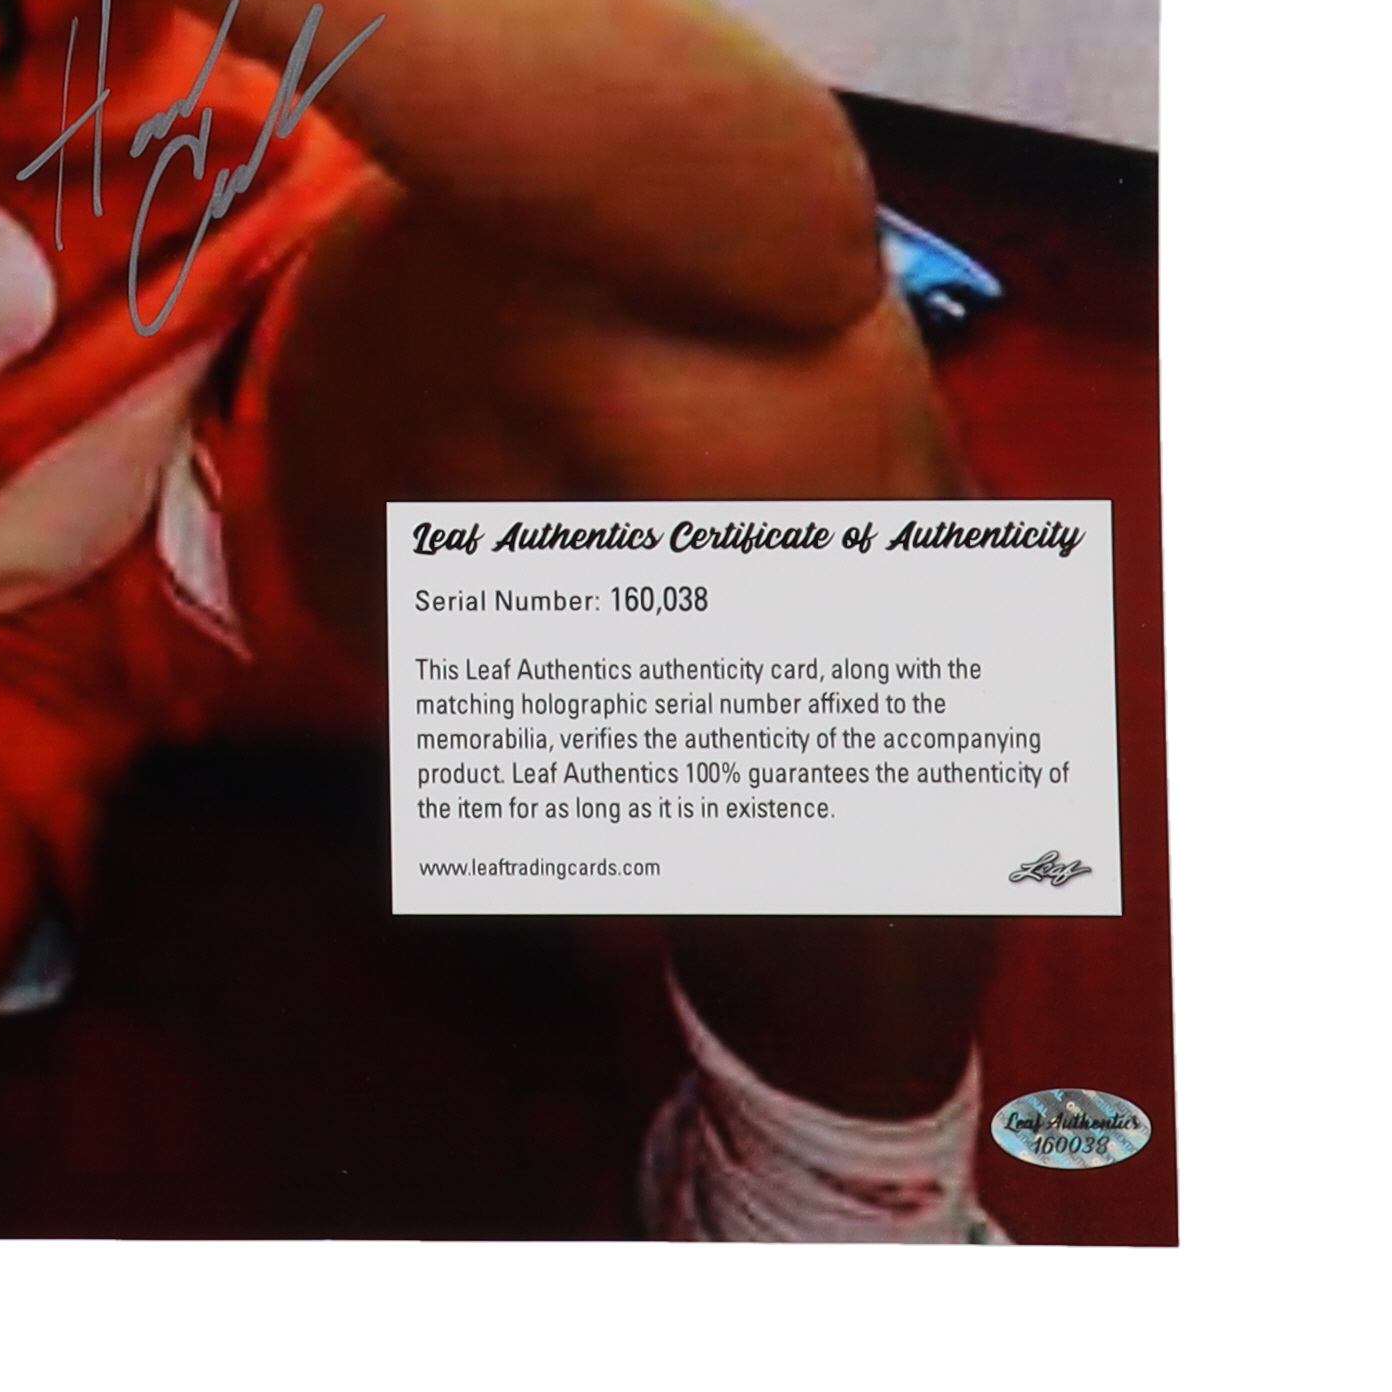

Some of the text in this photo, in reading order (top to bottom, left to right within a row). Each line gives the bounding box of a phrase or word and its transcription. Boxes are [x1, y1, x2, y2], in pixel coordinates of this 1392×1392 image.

[412, 520, 1086, 558] Leaf Authentics Certificate of Authenticity
[415, 585, 708, 616] Serial Number: 160,038
[415, 657, 981, 685] This Leaf Authentics authenticity card, along with the
[416, 691, 946, 720] matching holographic serial number affixed to the
[417, 726, 1041, 754] memorabilia, verifies the authenticity of the accompanying
[418, 761, 1070, 789] product. Leaf Authentics 100% guarantees the authenticity of
[417, 796, 835, 824] the item for as long as it is in existence.
[419, 857, 660, 880] www.leaftradingcards.com
[1009, 849, 1092, 886] Leaf
[1004, 1111, 1042, 1135] Leaf
[1045, 1111, 1140, 1131] Authentics
[1031, 1135, 1110, 1156] 160038
